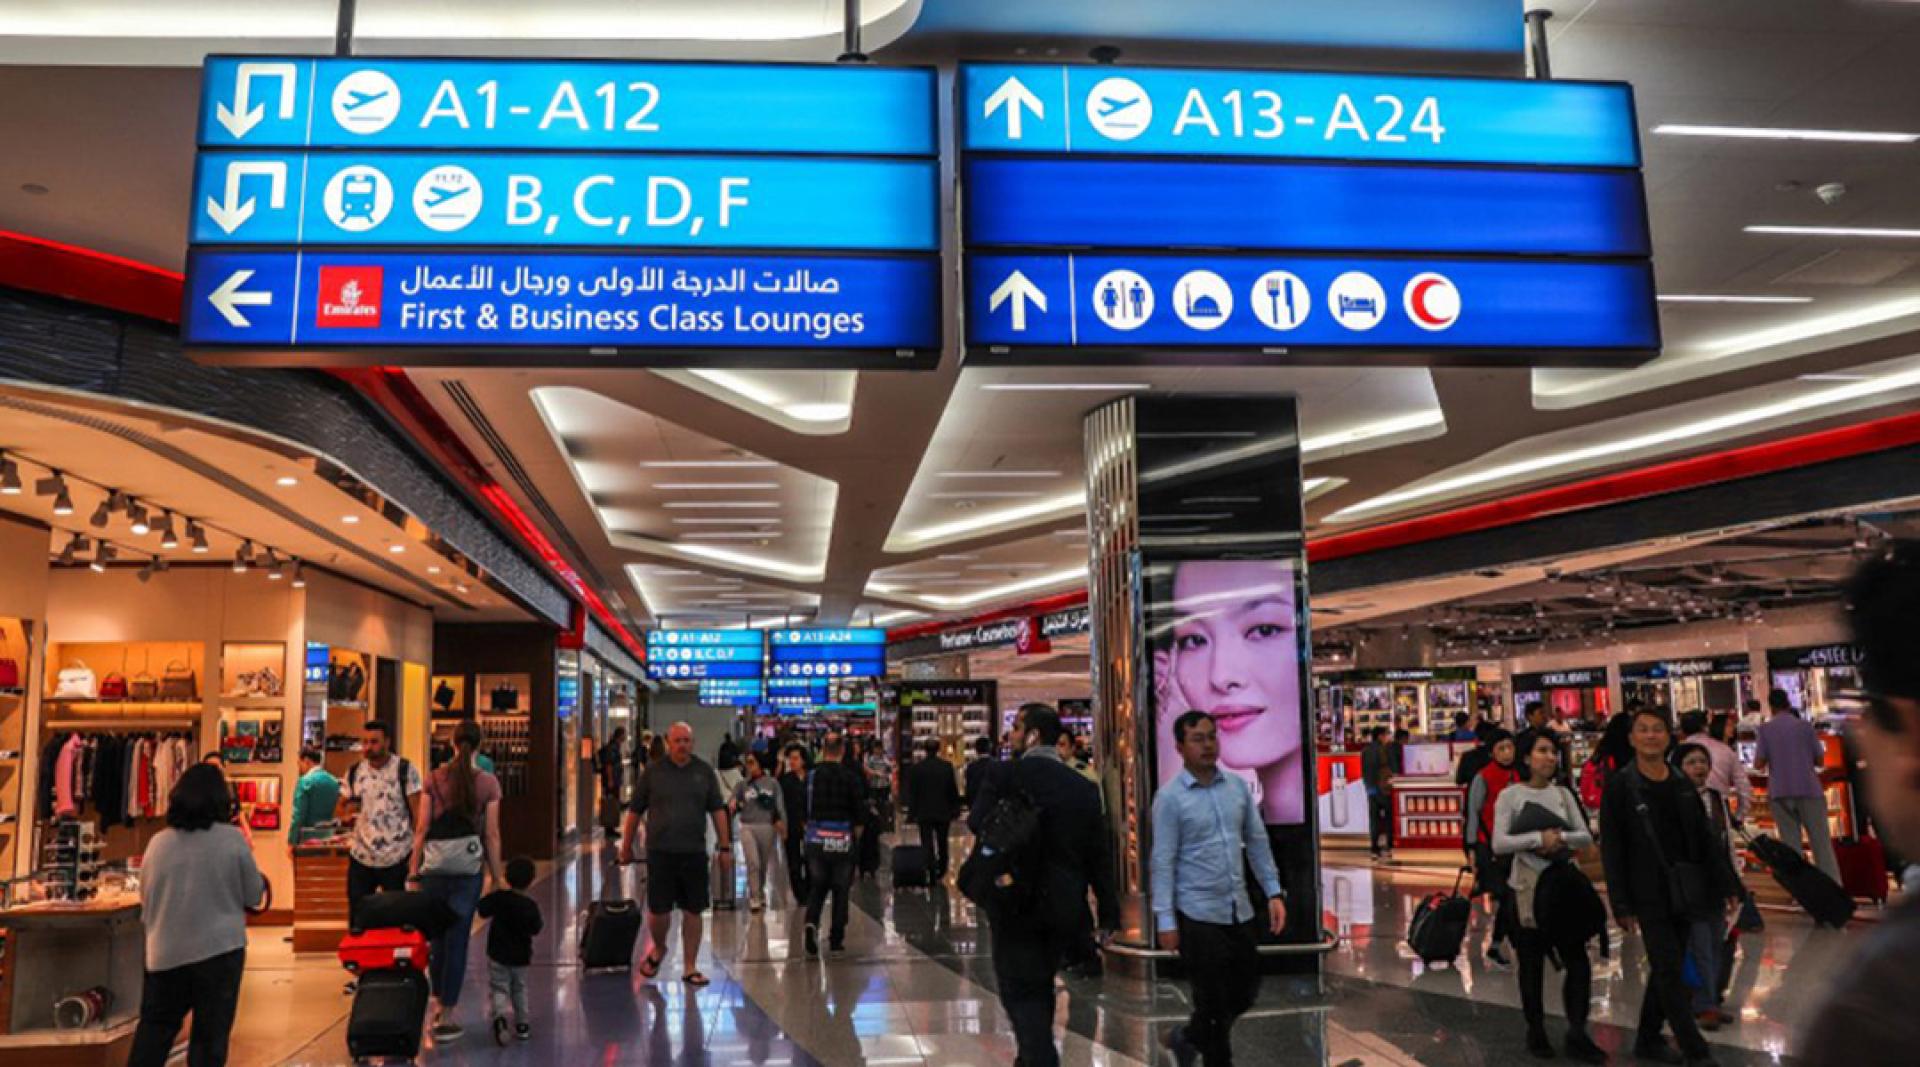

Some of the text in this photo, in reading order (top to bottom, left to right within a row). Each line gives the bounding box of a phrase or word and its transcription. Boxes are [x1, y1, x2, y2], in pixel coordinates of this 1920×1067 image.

[420, 79, 659, 131] A1-A12
[1173, 88, 1445, 144] A13-A24
[401, 266, 839, 296] صالات الدرجة الأولى ورجال الأعمال
[323, 303, 377, 316] Emirates
[401, 303, 864, 339] First & Business Class Lounges
